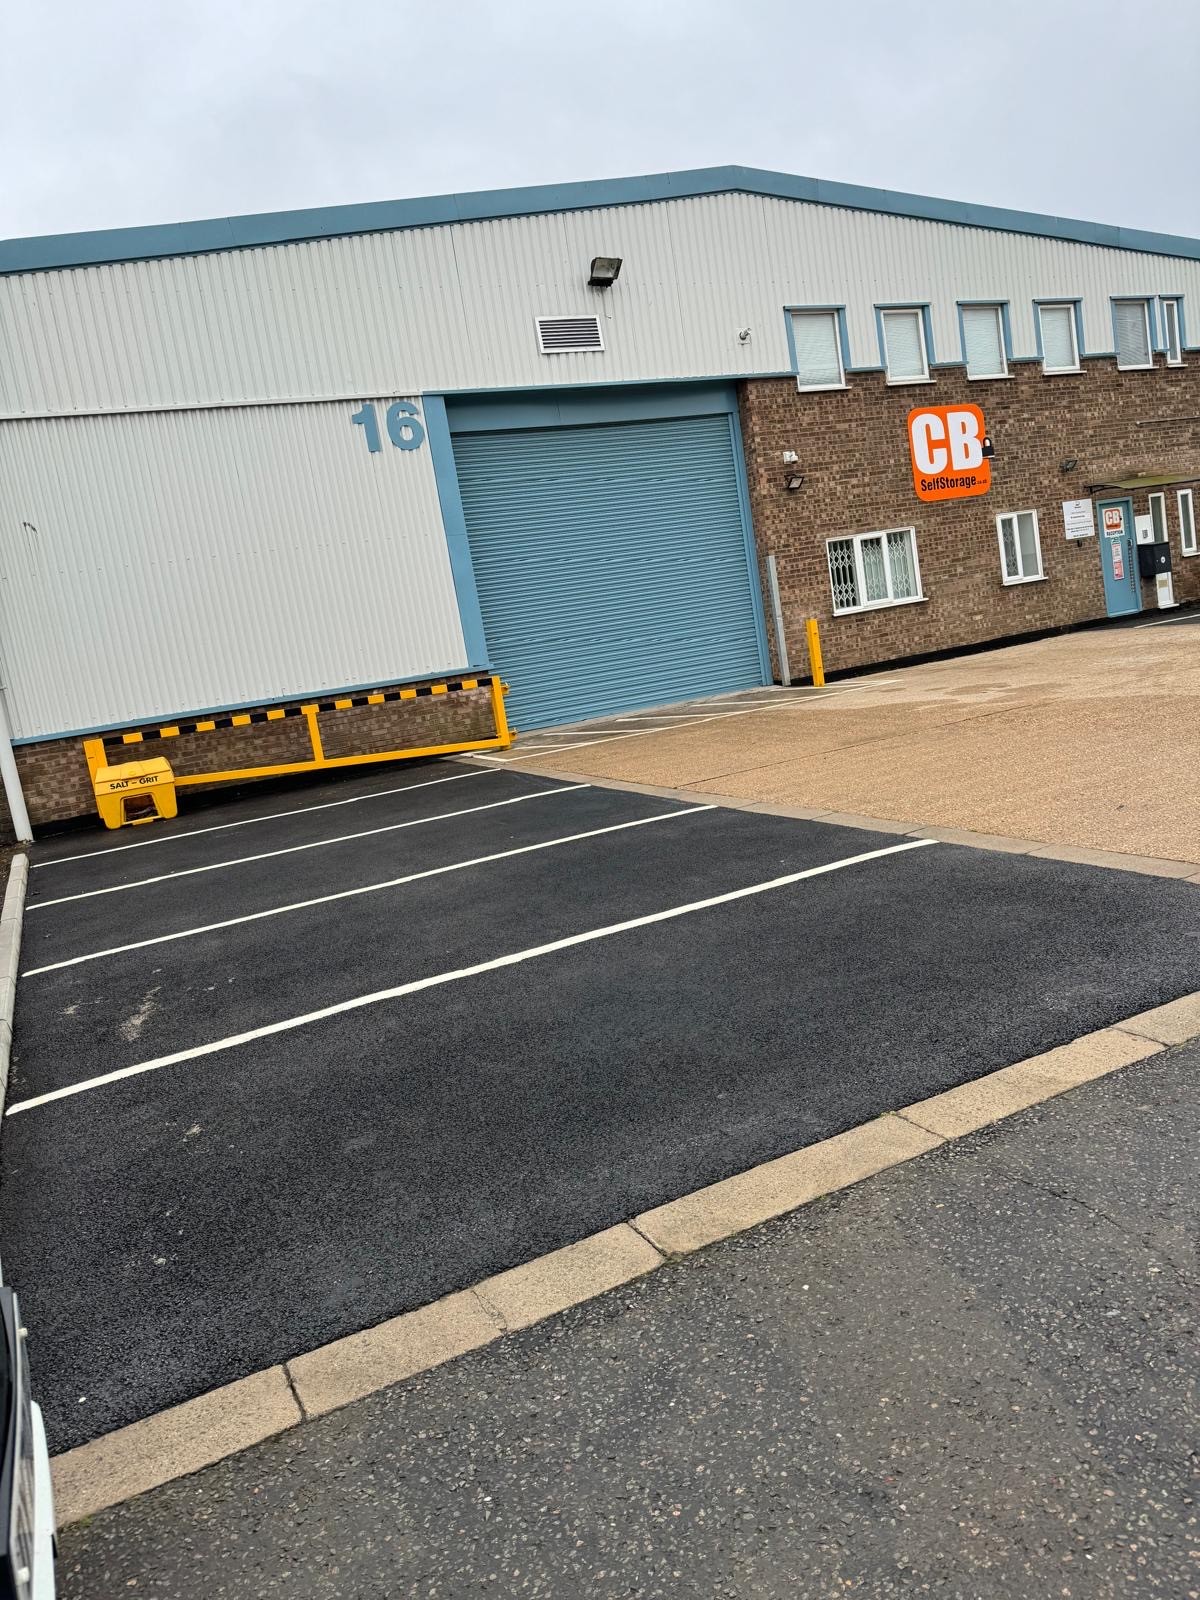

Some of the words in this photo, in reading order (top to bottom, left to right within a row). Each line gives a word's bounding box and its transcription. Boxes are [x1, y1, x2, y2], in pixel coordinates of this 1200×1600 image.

[352, 401, 425, 453] 16
[912, 411, 983, 475] CB
[1105, 510, 1121, 525] CB
[109, 780, 129, 790] SALT
[139, 775, 159, 785] GRIT
